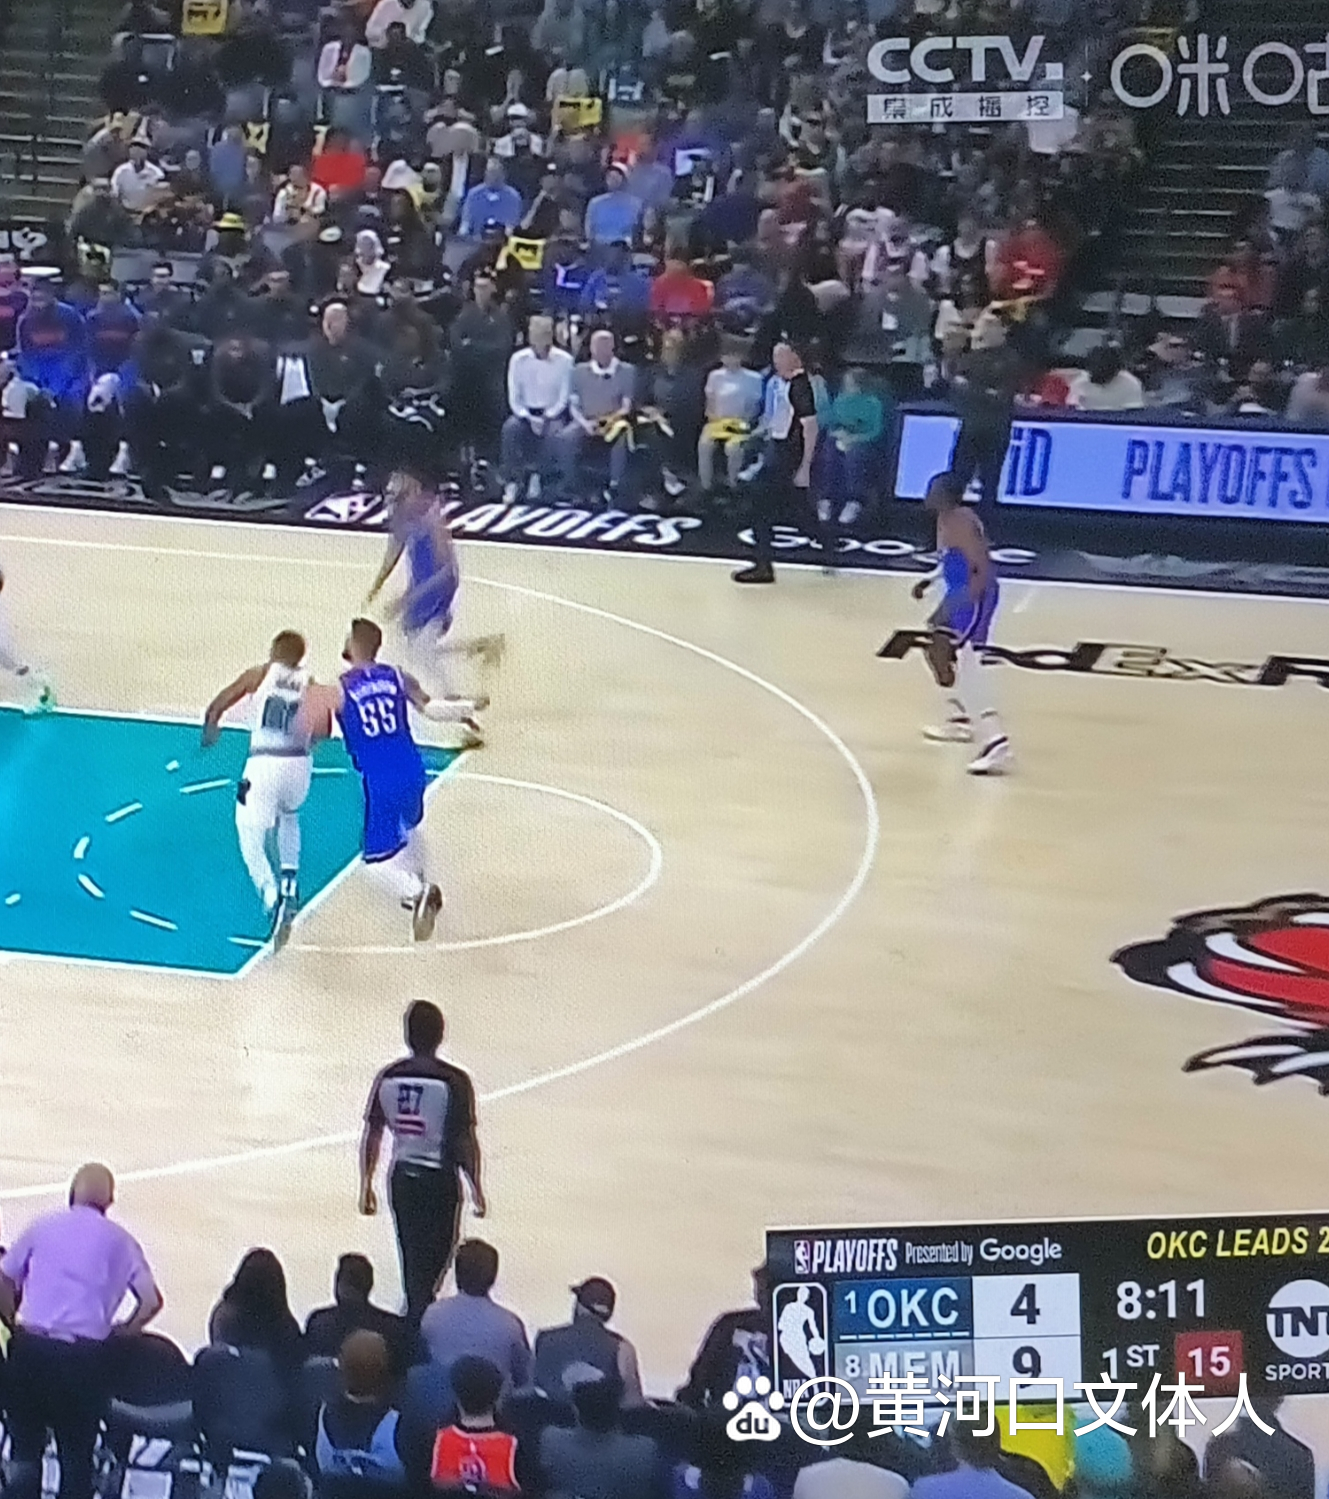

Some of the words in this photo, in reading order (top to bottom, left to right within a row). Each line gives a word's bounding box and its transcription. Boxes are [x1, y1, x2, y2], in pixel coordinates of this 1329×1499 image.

[867, 35, 1045, 84] CCTV
[1122, 439, 1318, 509] PLAYOFFS
[812, 1239, 899, 1273] PLAYOFFS
[905, 1242, 959, 1265] Presented
[959, 1241, 973, 1266] by
[980, 1237, 1062, 1265] Google
[1147, 1231, 1208, 1259] OKC
[1216, 1227, 1309, 1257] LEADS
[845, 1290, 857, 1314] 1
[867, 1287, 959, 1328] OKC
[1010, 1284, 1040, 1325] 4
[1117, 1279, 1205, 1320] 8:11
[845, 1355, 860, 1378] 8
[870, 1350, 961, 1389] MEM
[1013, 1346, 1041, 1389] 9
[1102, 1344, 1160, 1380] 1ST
[1188, 1346, 1231, 1378] 15
